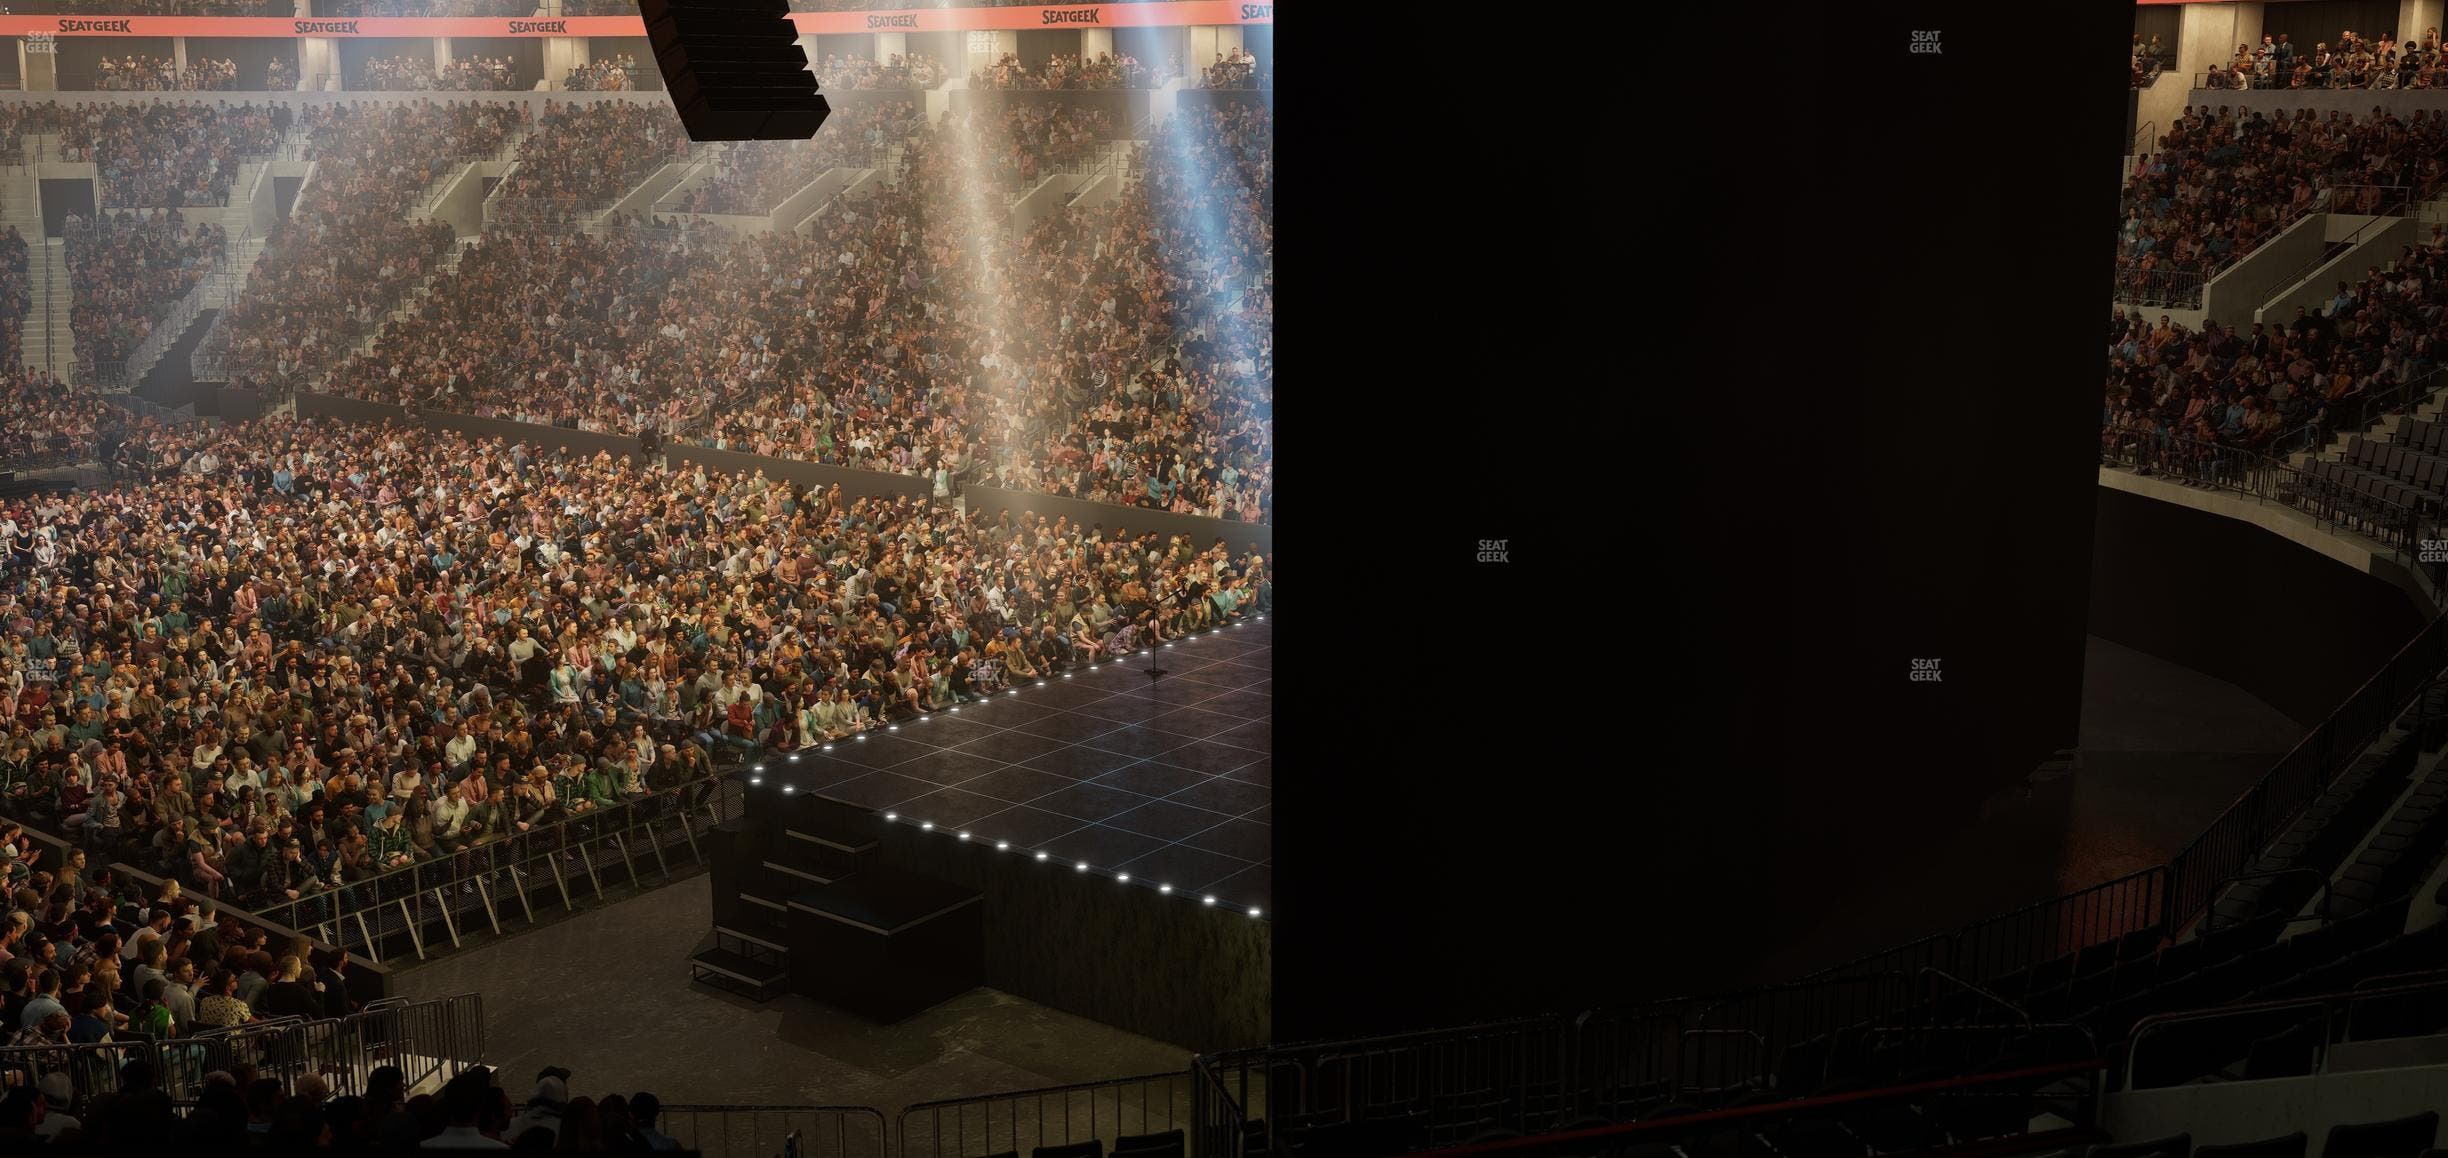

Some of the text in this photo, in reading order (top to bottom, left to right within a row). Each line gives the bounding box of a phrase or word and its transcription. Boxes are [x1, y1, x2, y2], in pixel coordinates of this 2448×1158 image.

[867, 13, 918, 28] SEATGEEK
[1042, 8, 1099, 24] SEATGEEK
[59, 19, 132, 33] SEATGEEK
[294, 20, 359, 33] SEATGEEK
[509, 20, 567, 33] SEATGEEK
